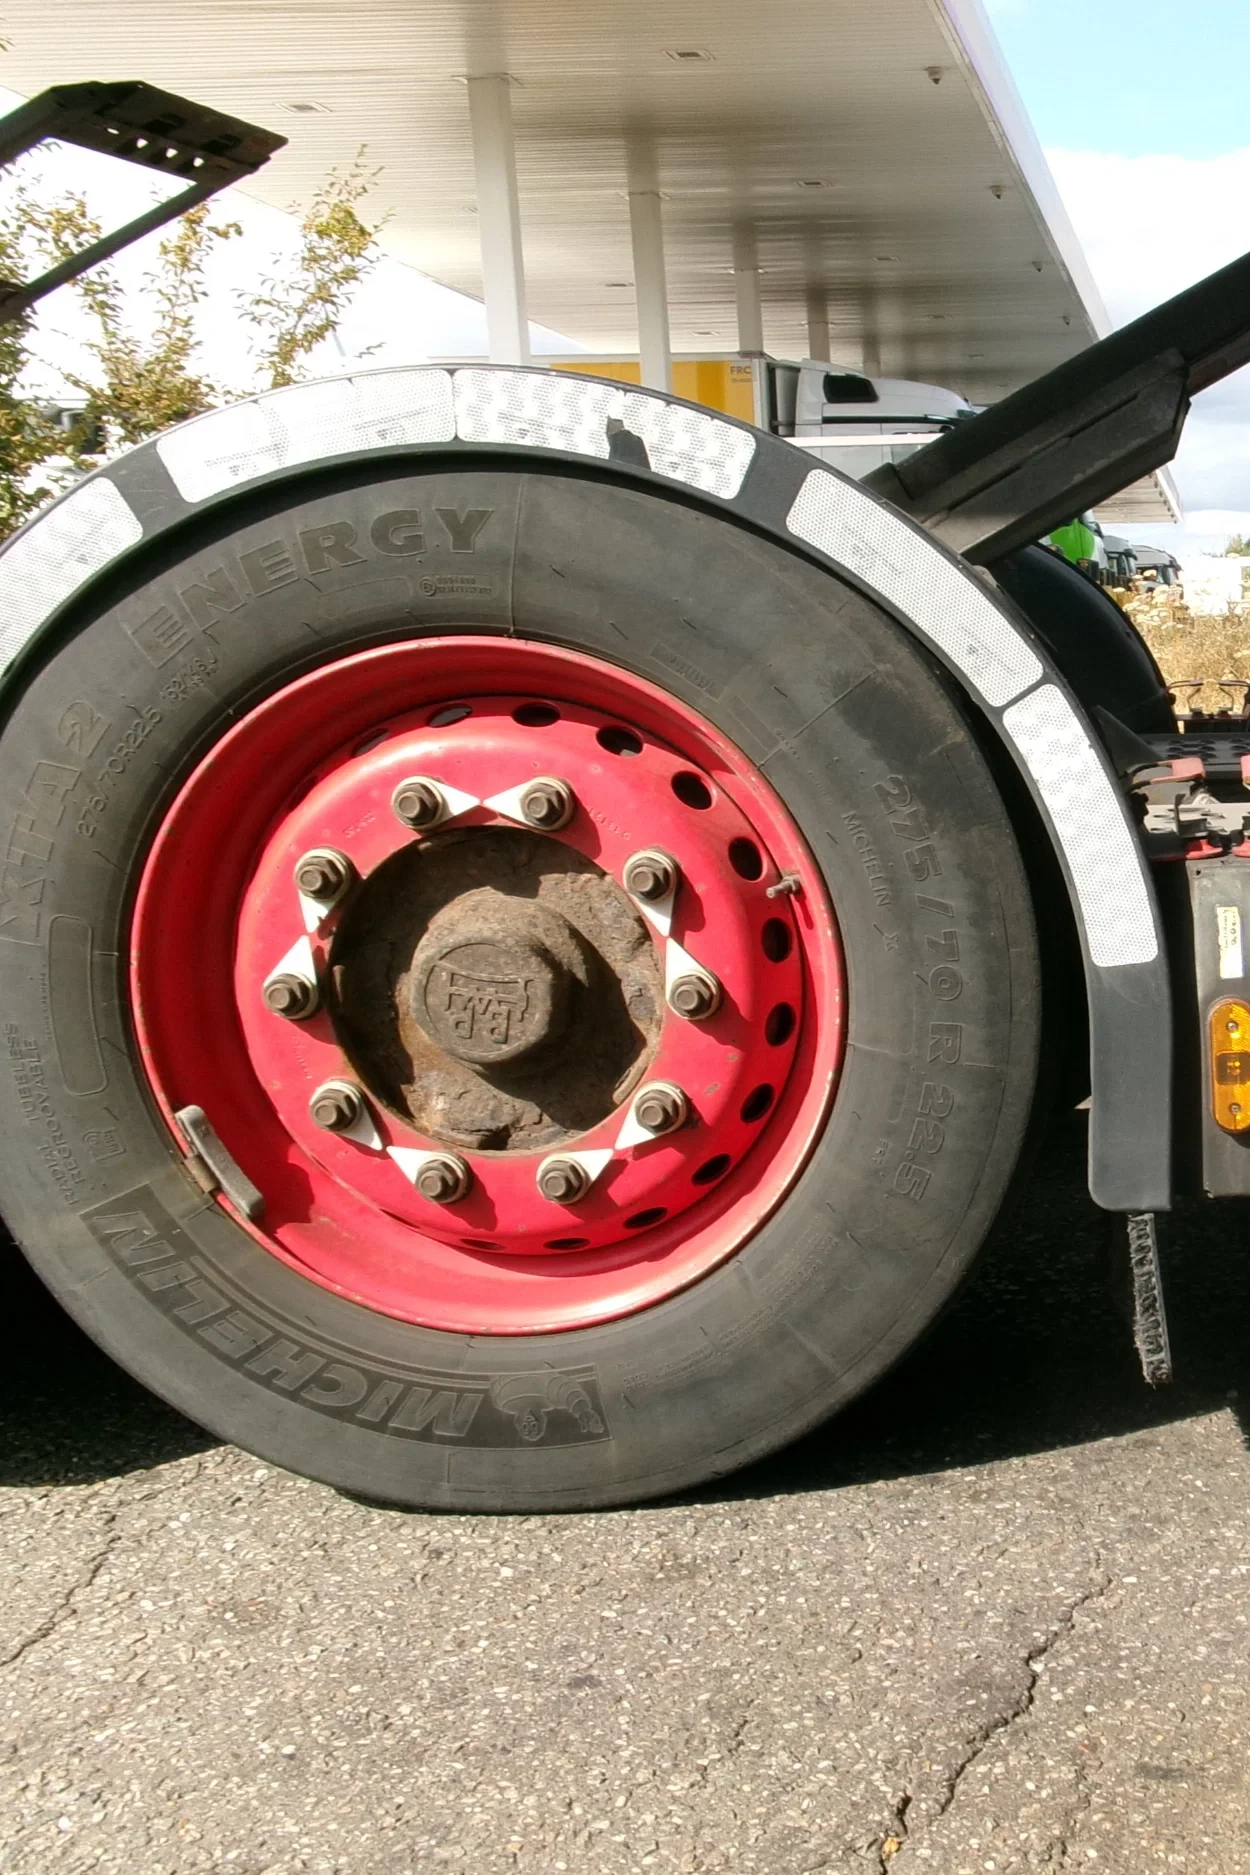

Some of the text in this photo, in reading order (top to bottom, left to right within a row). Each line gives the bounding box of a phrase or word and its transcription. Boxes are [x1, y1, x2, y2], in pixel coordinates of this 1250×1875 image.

[130, 507, 494, 668] ENERGY
[840, 808, 890, 908] MICHELIN
[23, 1037, 86, 1185] REGROOVABLE
[888, 1081, 956, 1202] 22.5
[97, 1211, 483, 1436] MICHELIN
